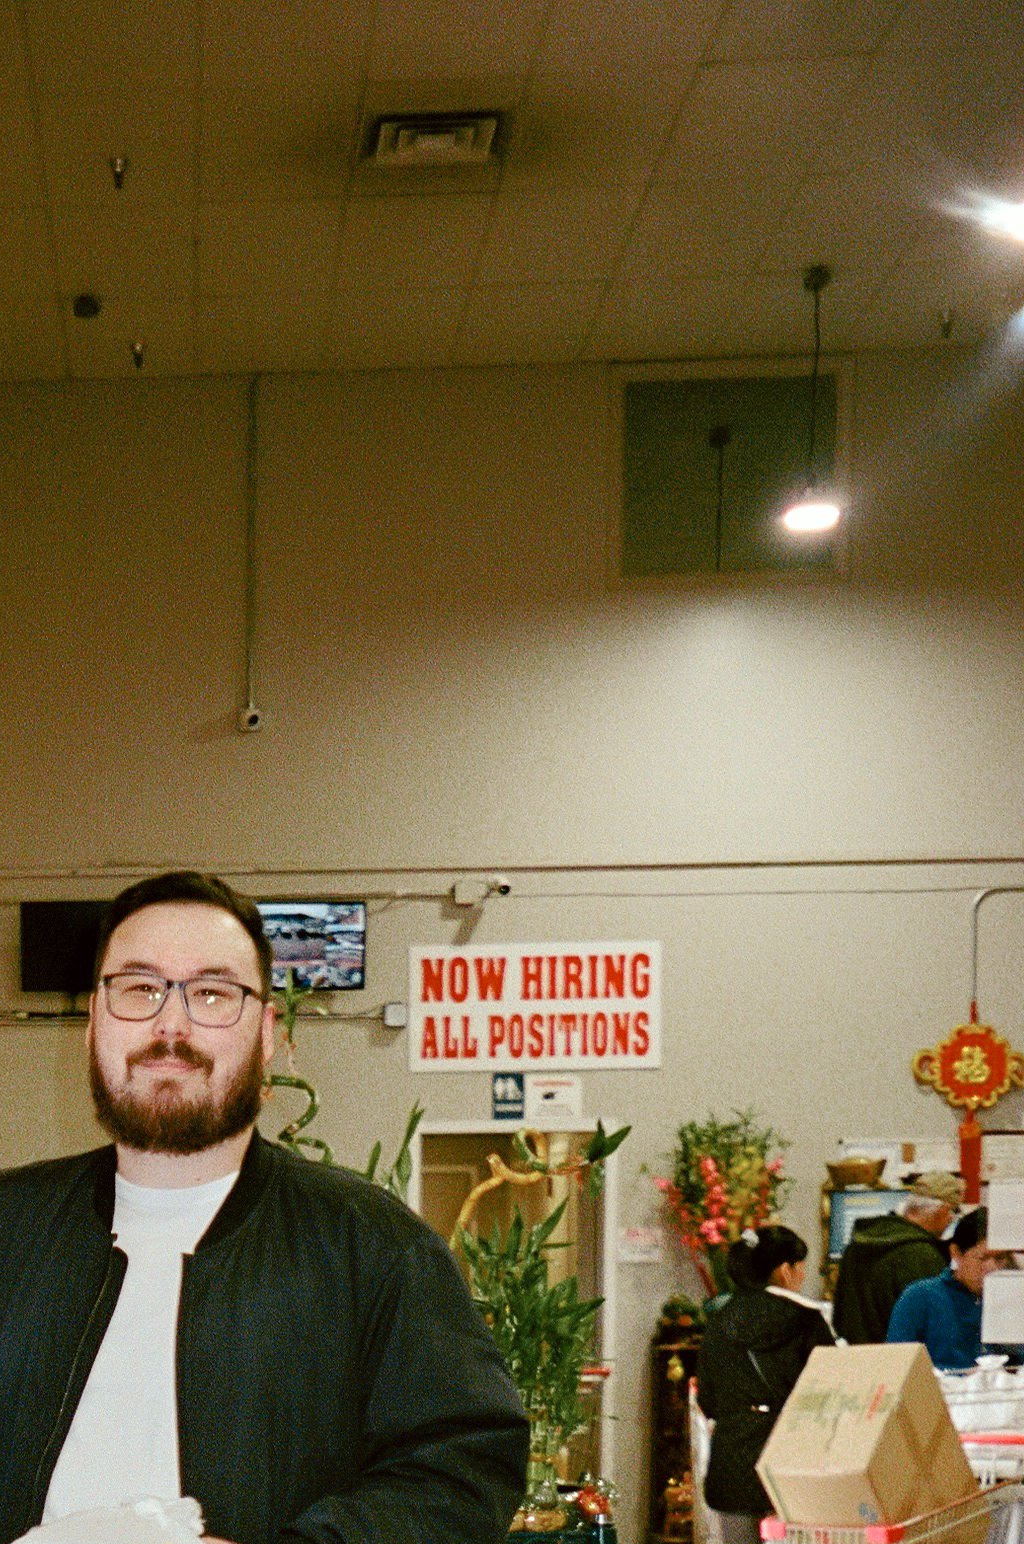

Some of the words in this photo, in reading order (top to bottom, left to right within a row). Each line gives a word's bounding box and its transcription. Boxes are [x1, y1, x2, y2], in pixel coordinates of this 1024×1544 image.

[421, 956, 507, 1003] NOW
[521, 953, 651, 1001] HIRING
[421, 1015, 478, 1059] ALL
[488, 1012, 650, 1059] POSITIONS
